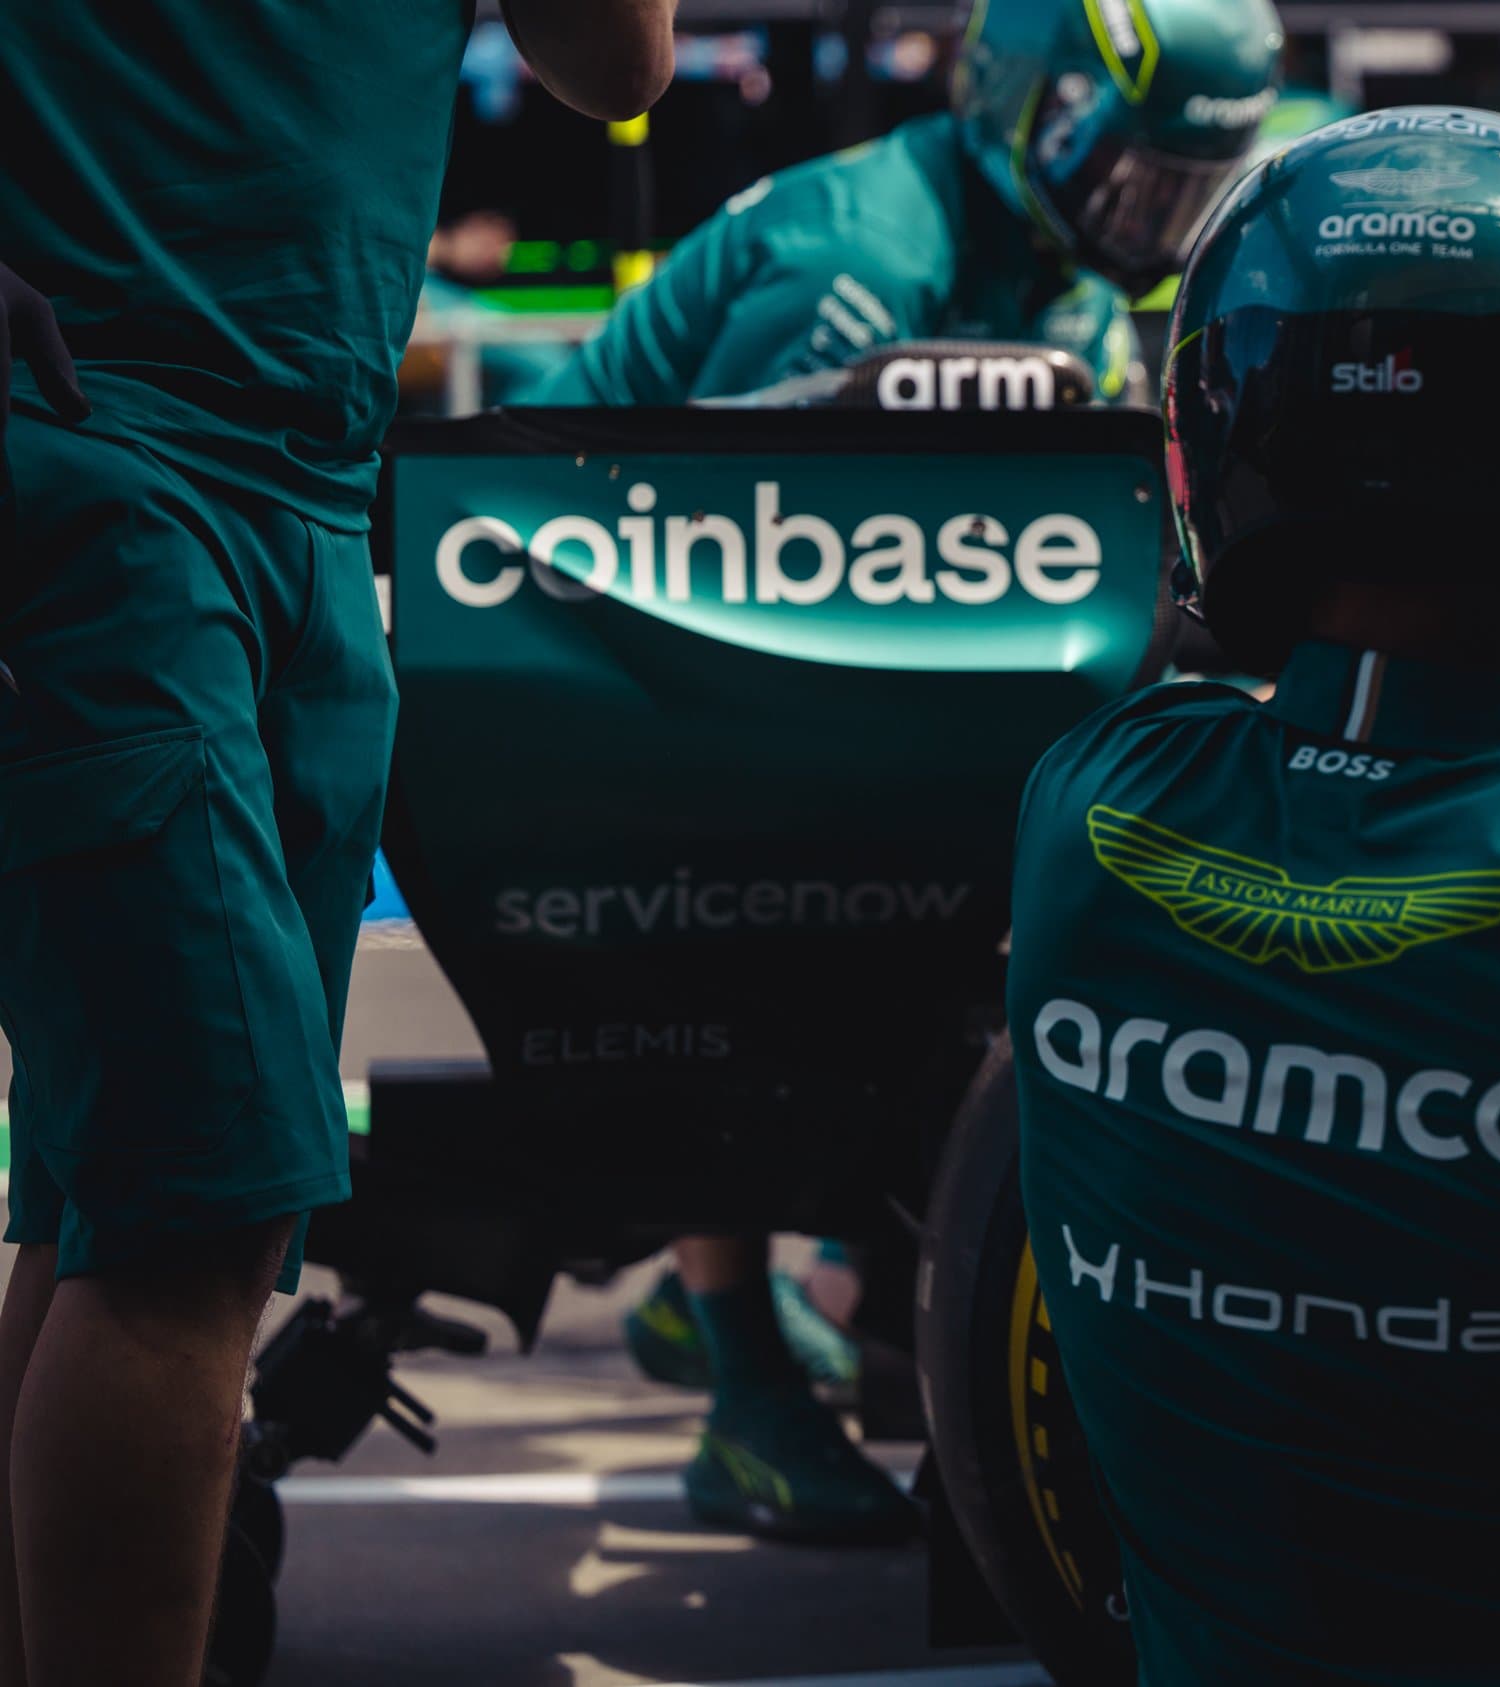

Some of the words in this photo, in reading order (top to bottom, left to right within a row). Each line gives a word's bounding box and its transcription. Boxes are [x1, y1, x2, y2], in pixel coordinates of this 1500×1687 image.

[1318, 211, 1478, 243] aramco
[1314, 242, 1387, 258] FORMULA
[1389, 242, 1423, 257] ONE
[1432, 243, 1474, 260] TEAM
[877, 356, 1056, 412] arm
[1330, 353, 1424, 393] Stilo
[434, 480, 1104, 609] coinbase
[1287, 745, 1397, 782] BOSS
[496, 866, 973, 939] servicenow
[1194, 871, 1290, 908] ASTON
[1292, 894, 1400, 920] MARTIN
[520, 1021, 733, 1066] ELEMIS
